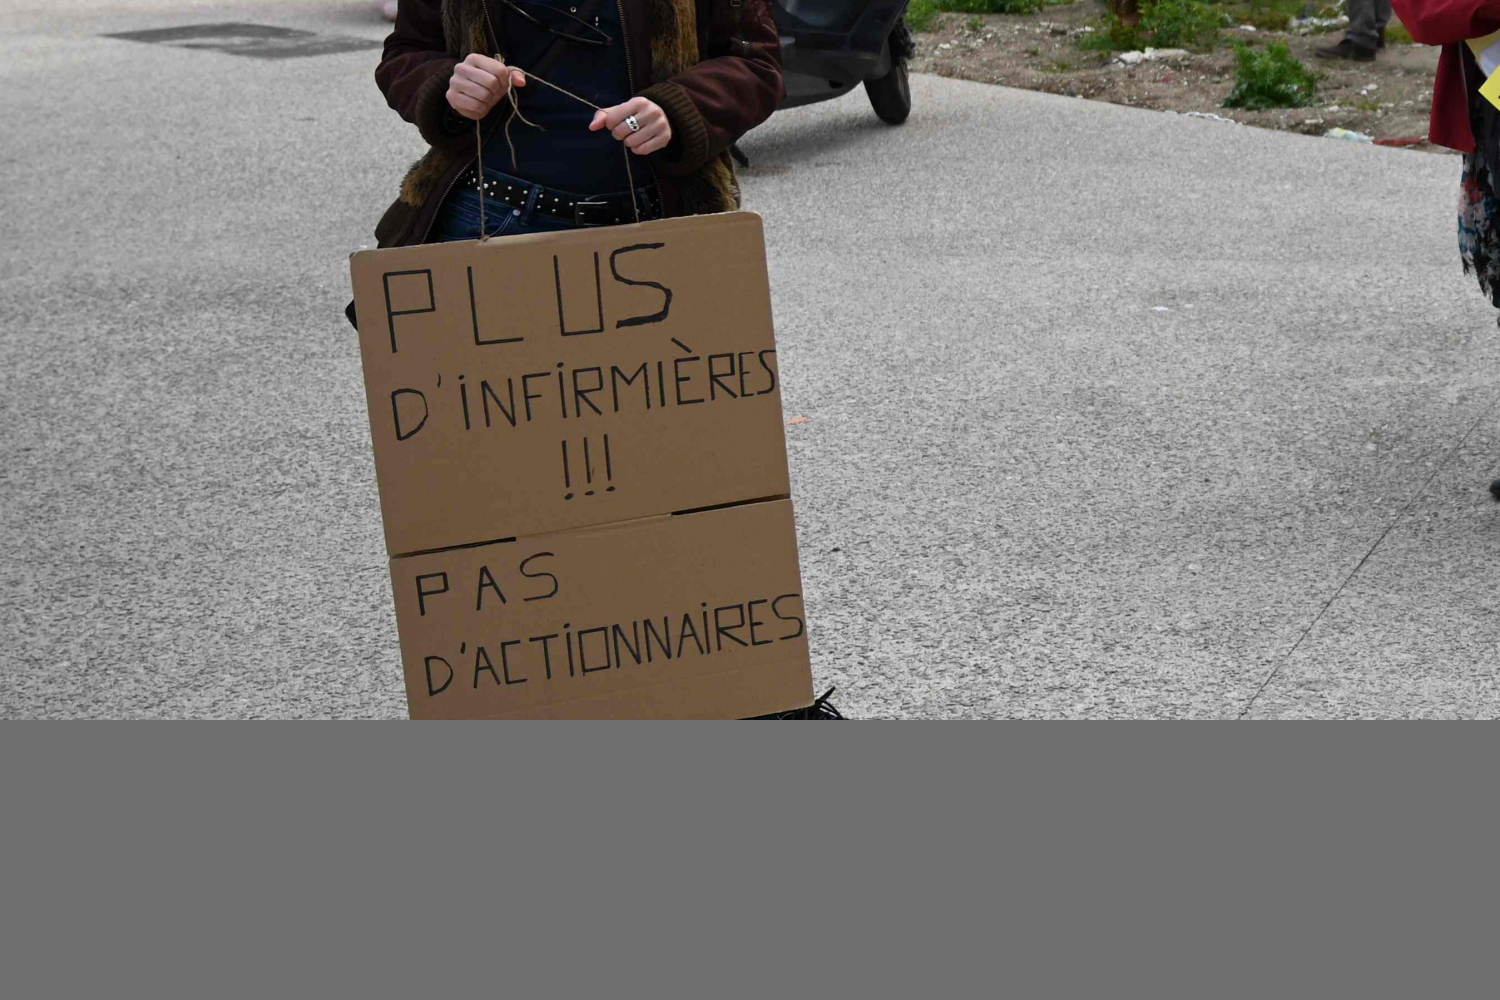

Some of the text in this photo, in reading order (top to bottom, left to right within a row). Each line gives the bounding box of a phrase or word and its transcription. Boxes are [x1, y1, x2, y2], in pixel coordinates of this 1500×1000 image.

[383, 242, 673, 353] PLUS
[391, 338, 778, 441] D'INFIRMIÈRES
[561, 433, 617, 500] !!!
[415, 552, 559, 616] PAS
[424, 592, 804, 696] D'ACTIONNAIRES
